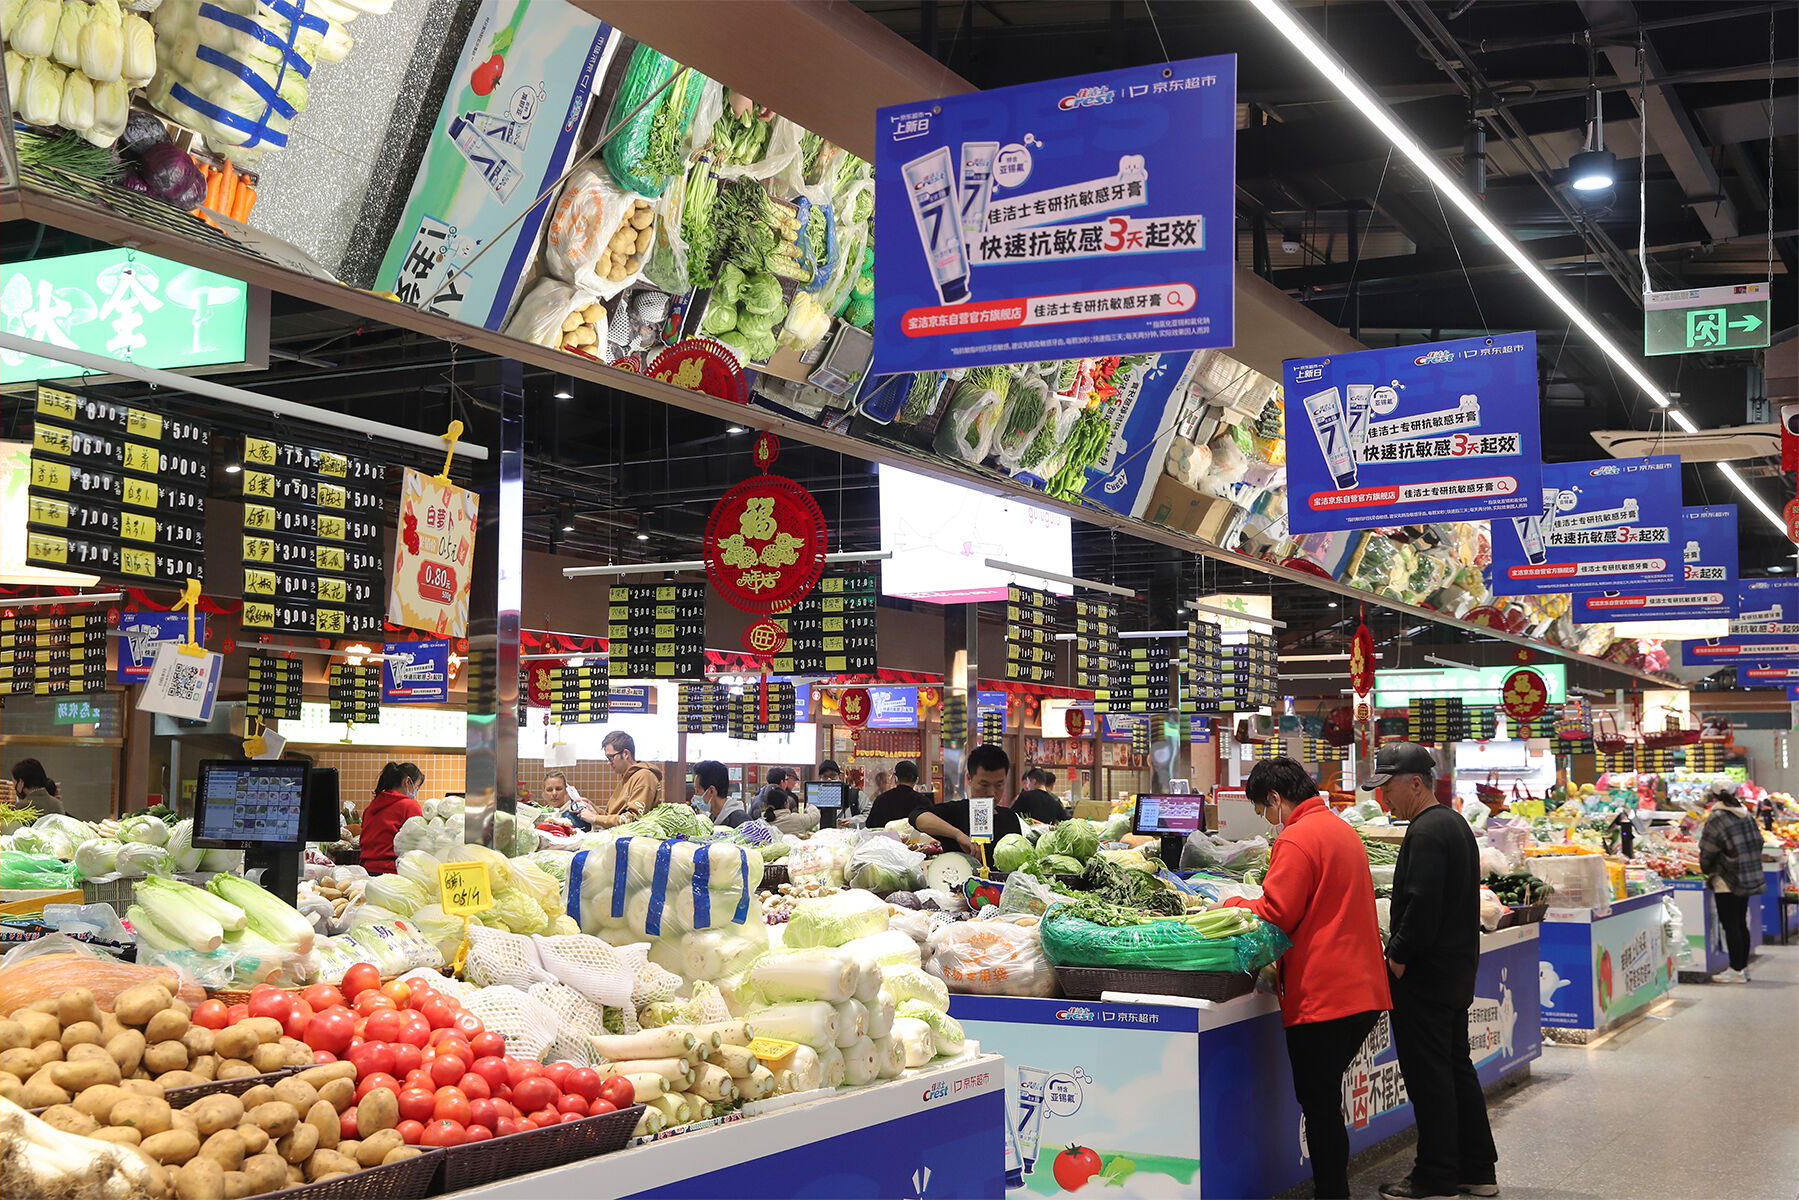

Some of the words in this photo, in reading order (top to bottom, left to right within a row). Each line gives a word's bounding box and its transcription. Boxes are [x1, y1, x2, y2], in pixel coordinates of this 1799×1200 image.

[1152, 74, 1217, 95] 京东超市
[1058, 91, 1114, 110] Crest
[893, 119, 929, 135] 上新日
[999, 162, 1025, 174] 亚锡氟
[962, 183, 987, 217] 7
[987, 180, 1142, 225] 佳洁士专研抗敏感牙膏
[921, 202, 945, 251] 7
[979, 217, 1198, 260] 快速抗敏感3天起效
[1033, 293, 1162, 318] 佳洁士专研抗敏感牙膏
[908, 307, 1022, 330] 宝洁京东自营官方旗舰店
[1480, 344, 1525, 356] 京东超市
[1414, 353, 1454, 366] Crest
[1295, 369, 1323, 379] 上新日
[163, 420, 199, 440] ¥5.00
[1367, 410, 1477, 439] 佳洁士专研抗敏感牙膏
[1319, 424, 1337, 455] 7
[1363, 434, 1517, 462] 快速抗敏感3天起效
[1639, 462, 1673, 472] 京东超市
[248, 474, 272, 496] 白菜
[1404, 482, 1494, 499] 佳洁士专研抗敏感牙膏
[158, 488, 194, 508] ¥1.50
[346, 490, 376, 508] ¥5.00
[1313, 490, 1396, 506] 宝洁京东自营官方旗舰店
[69, 506, 109, 526] ¥7.00
[276, 511, 308, 529] ¥0.50
[740, 497, 777, 541] 福
[1553, 510, 1637, 529] 佳洁士专研抗敏感牙膏
[157, 522, 192, 541] ¥1.50
[346, 521, 377, 539] ¥5.00
[1550, 527, 1666, 545] 快速抗敏感3天起效
[69, 542, 109, 562] ¥7.00
[275, 542, 307, 560] ¥3.00
[157, 557, 193, 576] ¥5.00
[345, 552, 375, 570] ¥5.00
[1581, 561, 1649, 572] 佳洁士专研抗敏感牙膏
[275, 575, 307, 593] ¥6.00
[1649, 595, 1708, 604] 佳洁士专研抗敏感牙膏
[275, 607, 307, 626] ¥9.00
[345, 615, 375, 632] ¥3.50
[1730, 622, 1799, 634] 速抗敏感3天起效
[1055, 1009, 1095, 1021] Crest
[1117, 1012, 1160, 1024] 京东超市
[963, 1072, 990, 1092] 京东超市
[922, 1085, 949, 1102] Crest
[1050, 1092, 1075, 1104] 亚锡氟
[1018, 1104, 1036, 1132] 7
